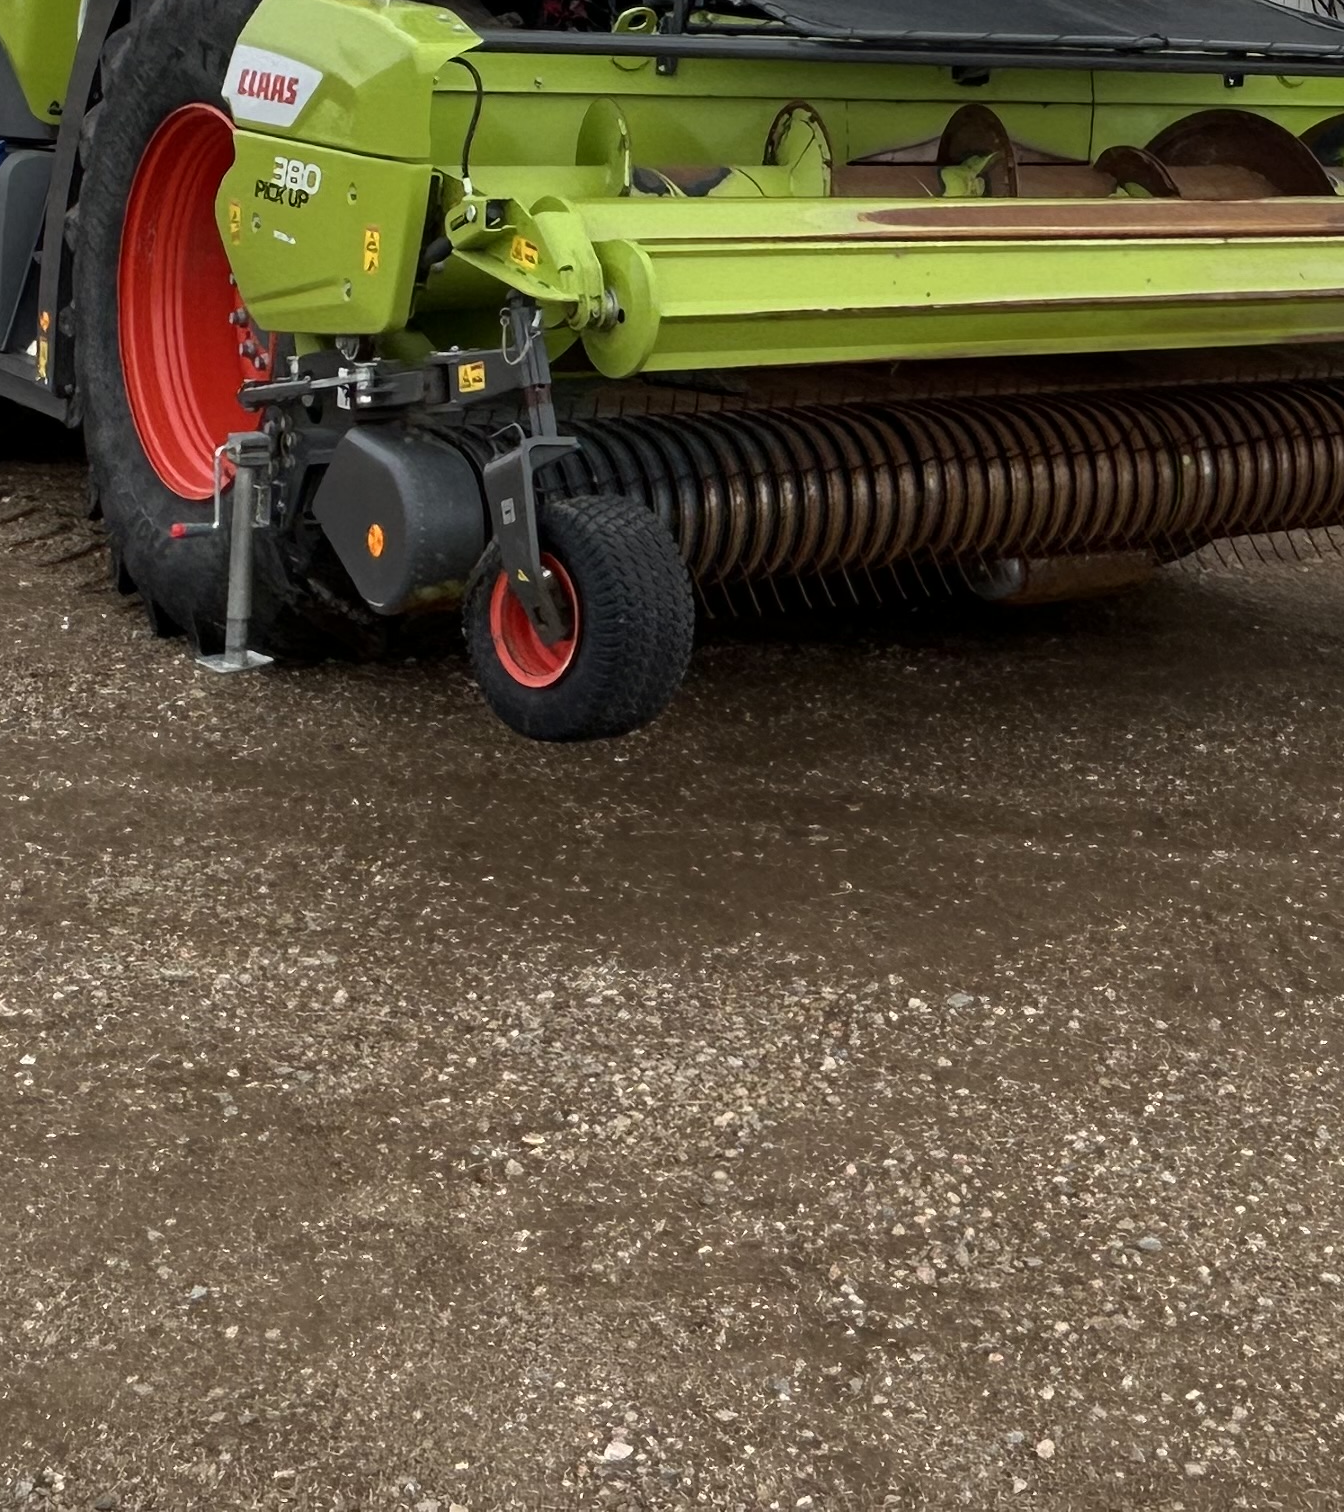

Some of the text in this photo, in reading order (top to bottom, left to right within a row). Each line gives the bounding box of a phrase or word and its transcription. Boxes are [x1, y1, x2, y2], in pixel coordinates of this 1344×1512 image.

[237, 69, 299, 105] CLAAS
[255, 179, 310, 208] PICK UP
[271, 156, 322, 195] 380
